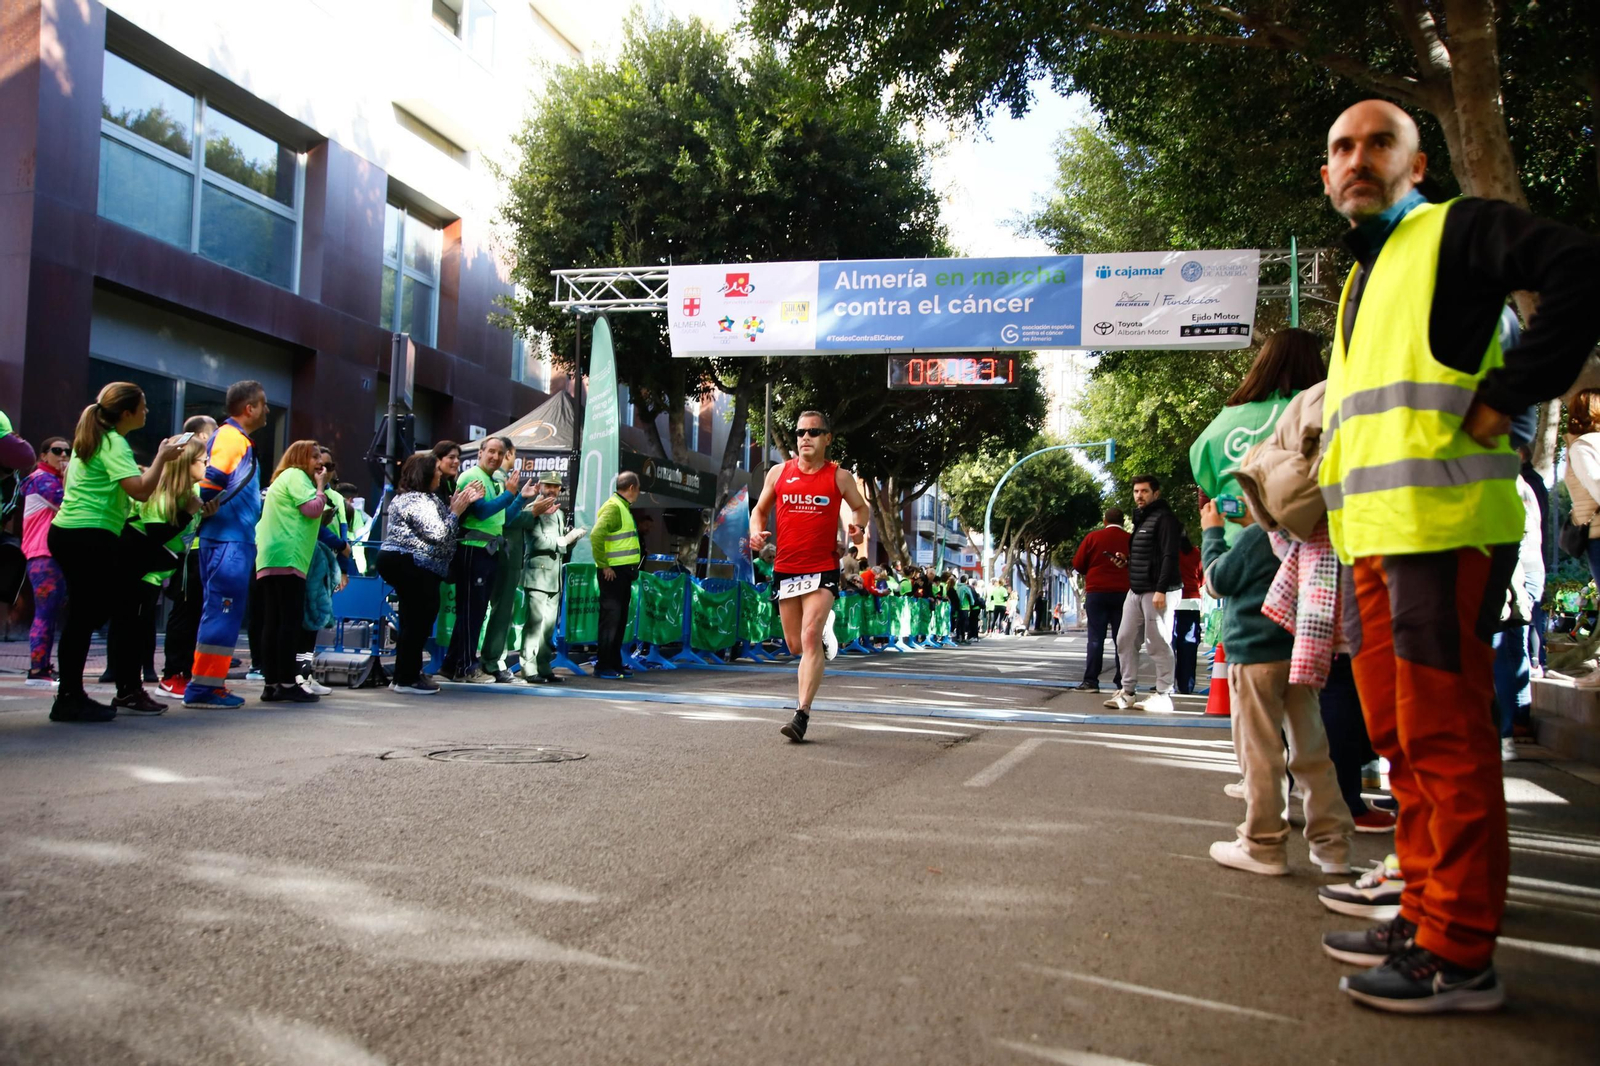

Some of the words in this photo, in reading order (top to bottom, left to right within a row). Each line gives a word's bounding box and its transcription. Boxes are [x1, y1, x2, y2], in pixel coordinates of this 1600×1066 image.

[834, 268, 927, 290] Almería
[935, 271, 964, 287] en
[973, 265, 1066, 286] marcha
[1115, 265, 1165, 279] cajamar
[833, 297, 911, 317] contra
[918, 294, 941, 315] el
[947, 294, 1034, 314] cáncer
[1162, 294, 1220, 306] Fundación
[673, 319, 707, 329] ALMERÍA
[1191, 313, 1212, 323] Ejido
[1213, 312, 1240, 320] Motor
[826, 334, 905, 342] #TodosContraElCáncer
[787, 580, 812, 594] 213
